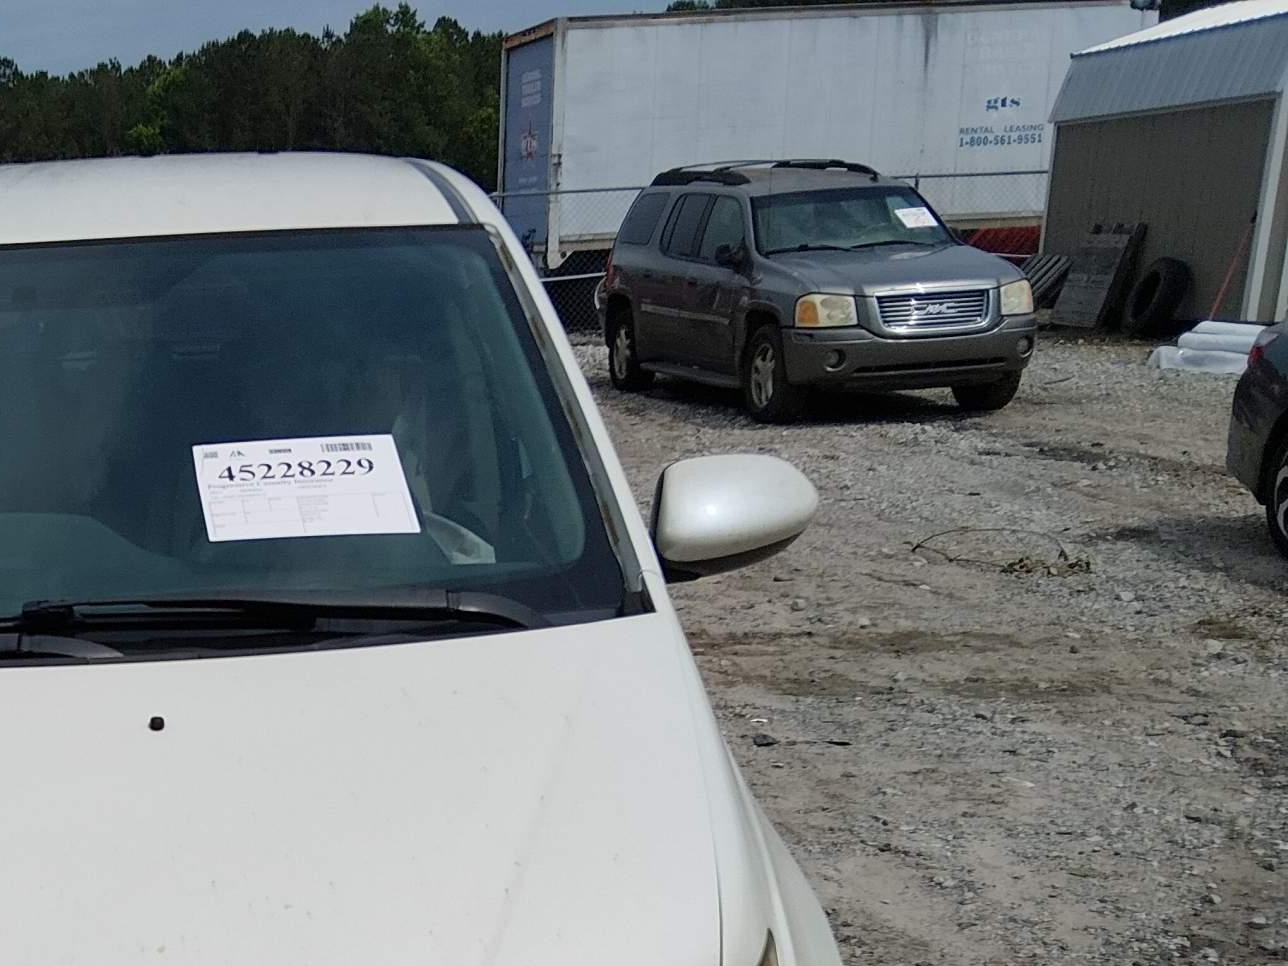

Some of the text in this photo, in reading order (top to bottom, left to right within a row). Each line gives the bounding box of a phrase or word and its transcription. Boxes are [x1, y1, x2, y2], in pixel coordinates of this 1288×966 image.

[985, 97, 1021, 112] gts
[959, 124, 1044, 134] RENTAL LEASING
[959, 134, 1043, 147] 1-800-561-9551
[218, 458, 375, 482] 45228229
